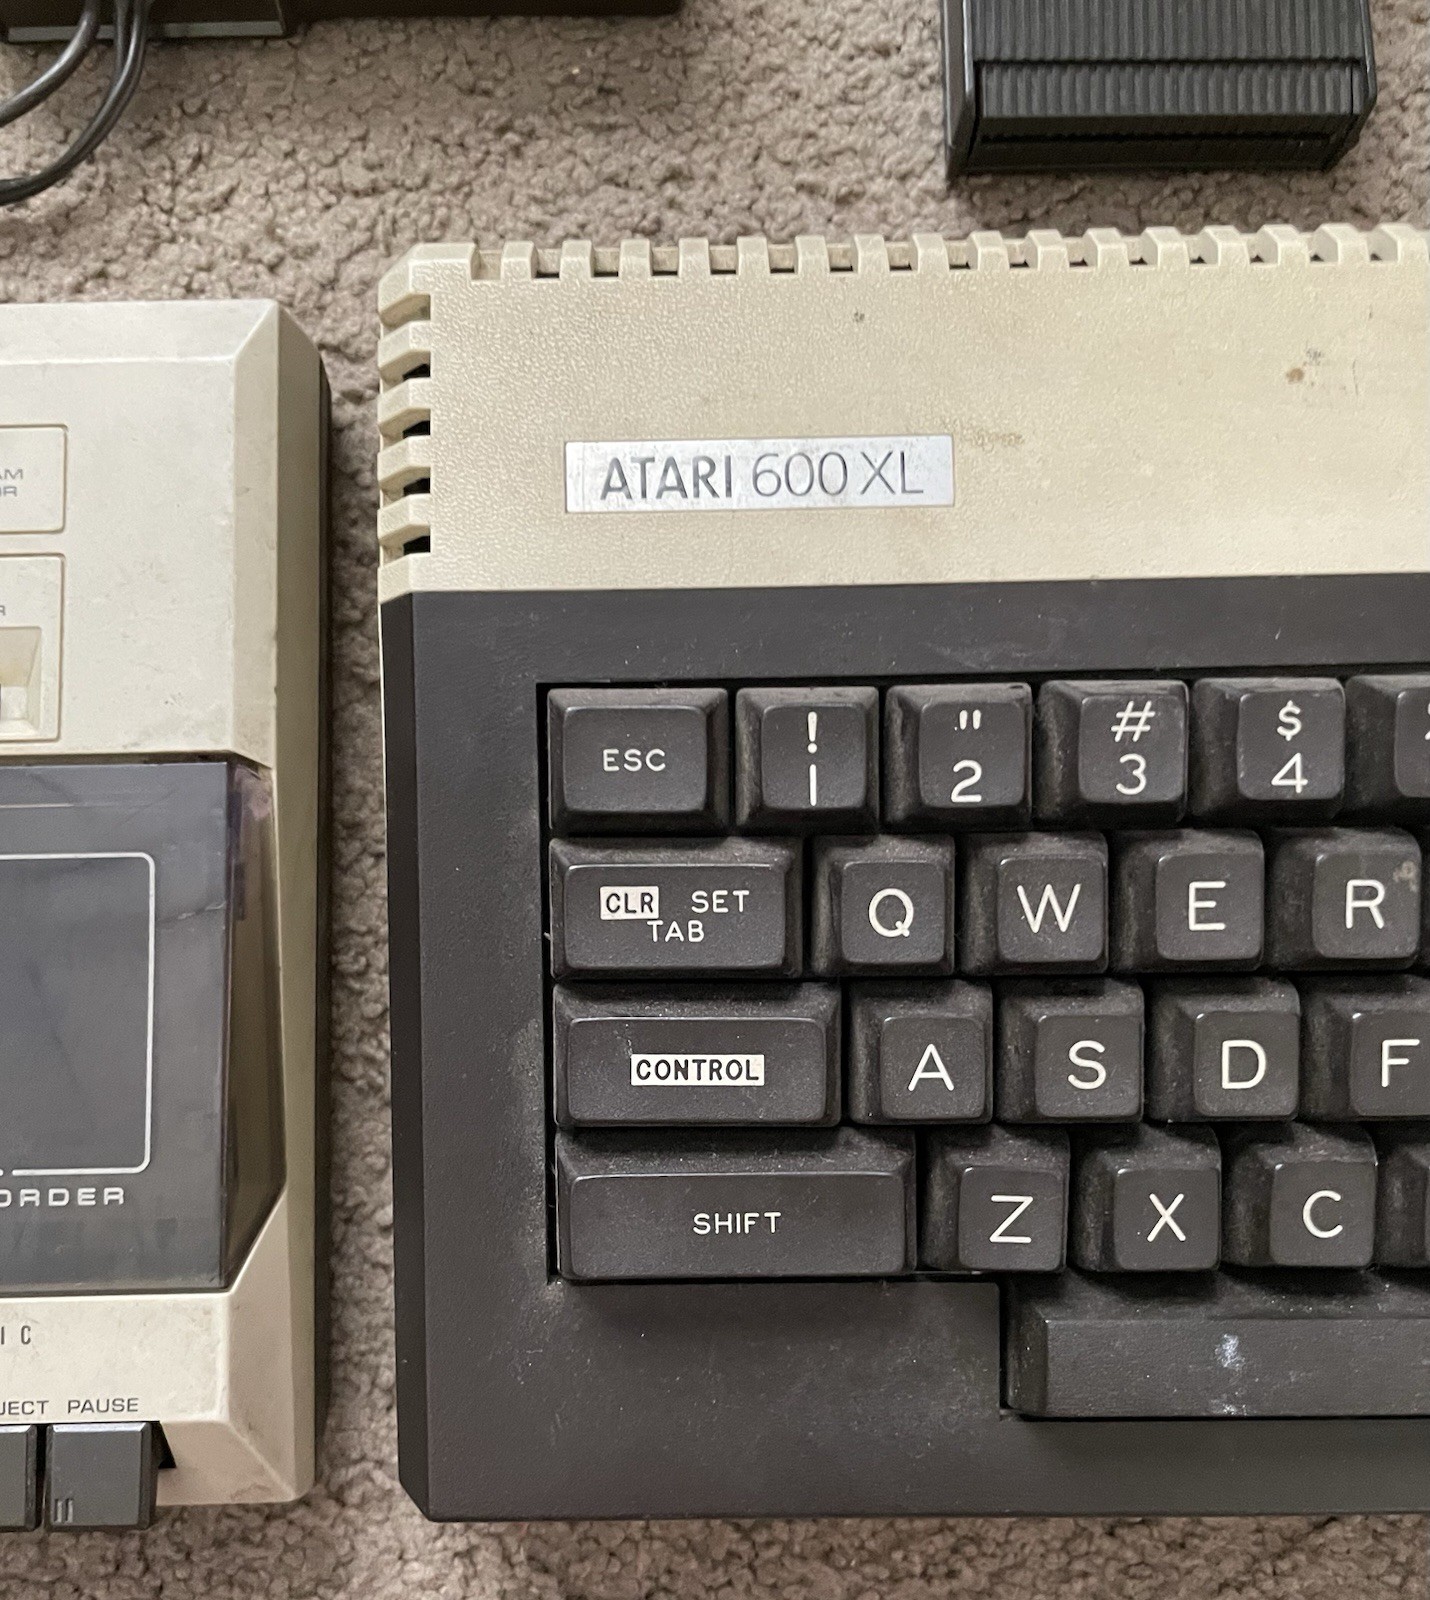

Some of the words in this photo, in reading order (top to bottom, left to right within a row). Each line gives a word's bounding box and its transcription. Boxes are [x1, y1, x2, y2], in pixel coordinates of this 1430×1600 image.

[0, 468, 24, 480] M
[600, 455, 732, 500] ATARI
[752, 451, 848, 497] 600
[860, 450, 924, 495] XL
[807, 711, 818, 754] !
[1110, 700, 1156, 743] #
[1276, 700, 1302, 742] $
[603, 748, 666, 772] ESC
[950, 759, 982, 803] 2
[1116, 753, 1147, 795] 3
[1271, 752, 1309, 794] 4
[605, 892, 655, 914] CLR
[691, 889, 750, 914] SET
[868, 888, 914, 938] Q
[1016, 883, 1081, 934] W
[1188, 880, 1226, 931] E
[1345, 879, 1386, 929] R
[646, 920, 705, 943] TAB
[635, 1058, 760, 1081] CONTROL
[908, 1043, 955, 1092] A
[1067, 1040, 1107, 1090] S
[1221, 1039, 1267, 1090] D
[1381, 1038, 1421, 1088] F
[693, 1211, 782, 1235] SHIFT
[989, 1195, 1034, 1244] Z
[1146, 1193, 1186, 1242] X
[1302, 1190, 1343, 1239] C
[67, 1397, 139, 1415] PAUSE
